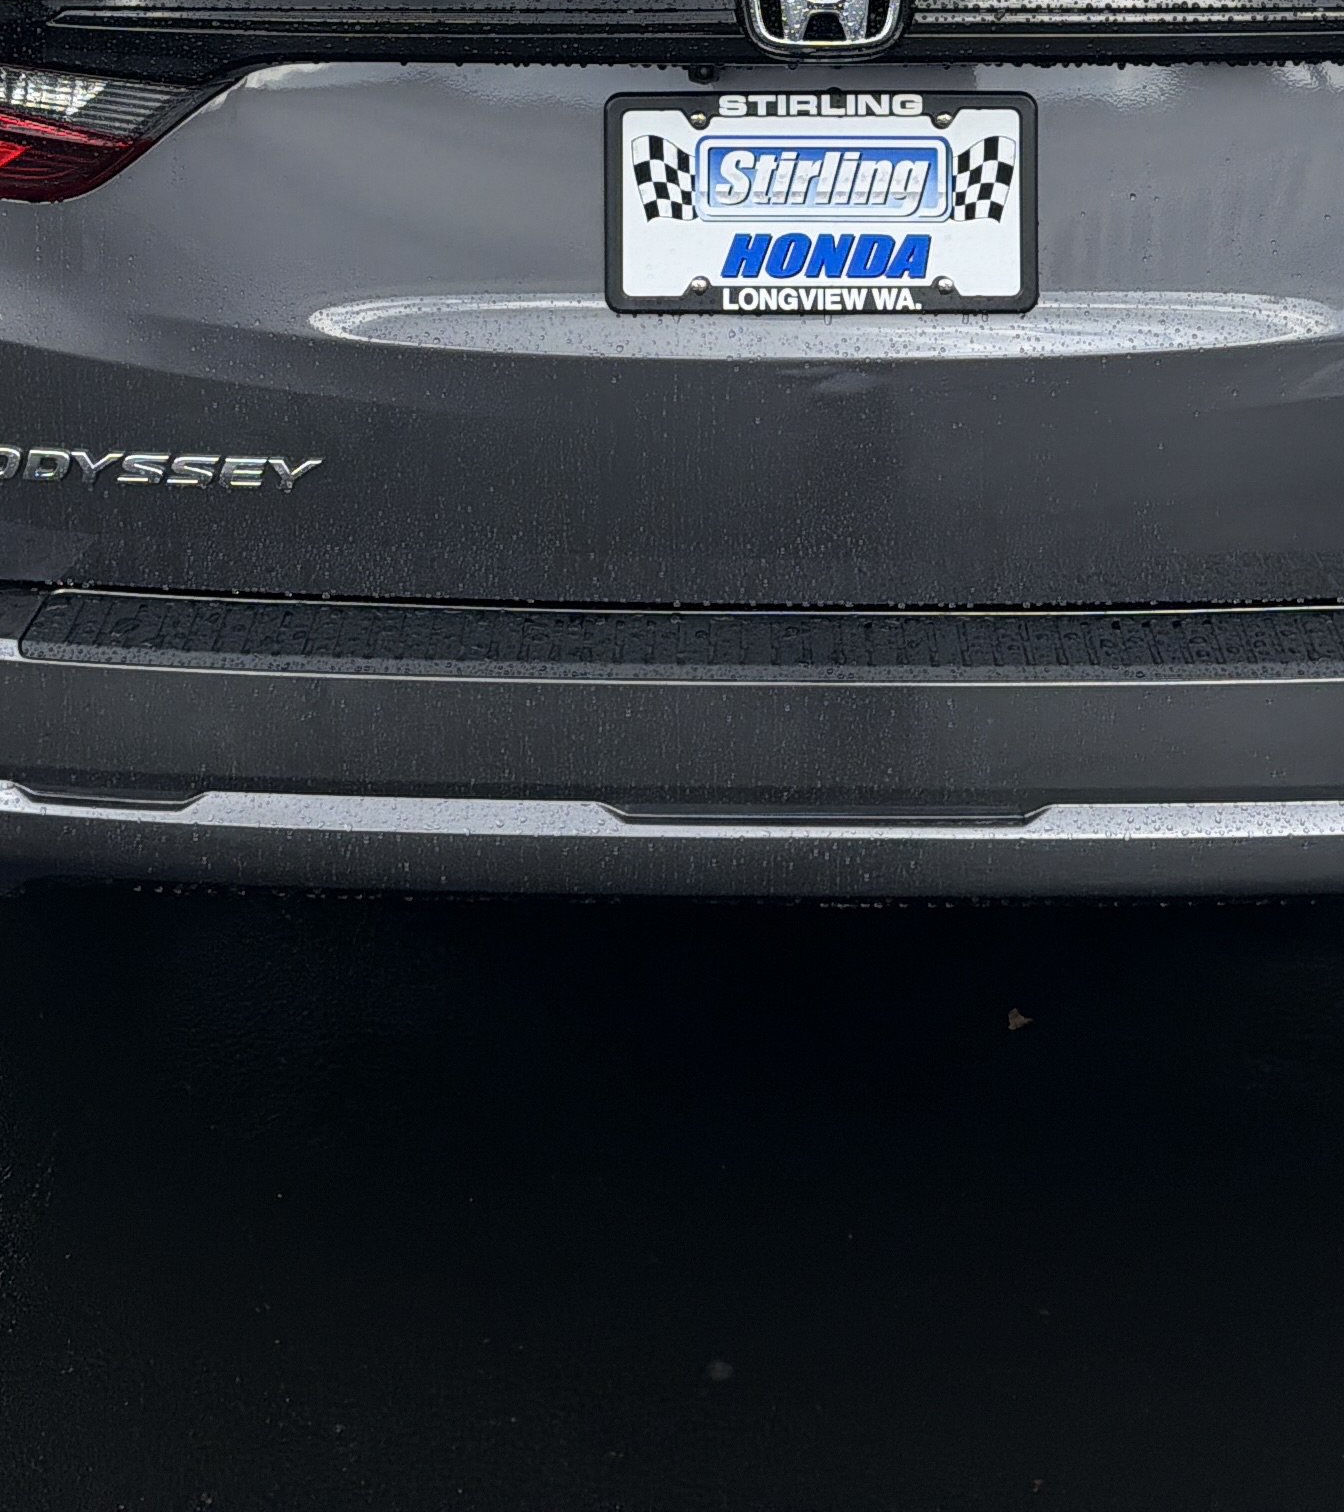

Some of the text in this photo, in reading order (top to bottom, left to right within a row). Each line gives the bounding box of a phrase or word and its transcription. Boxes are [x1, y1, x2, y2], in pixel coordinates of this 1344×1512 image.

[719, 94, 923, 116] STIRLING
[715, 149, 931, 216] Stirling
[721, 233, 931, 279] HONDA
[722, 288, 922, 311] LONGVIEW WA.
